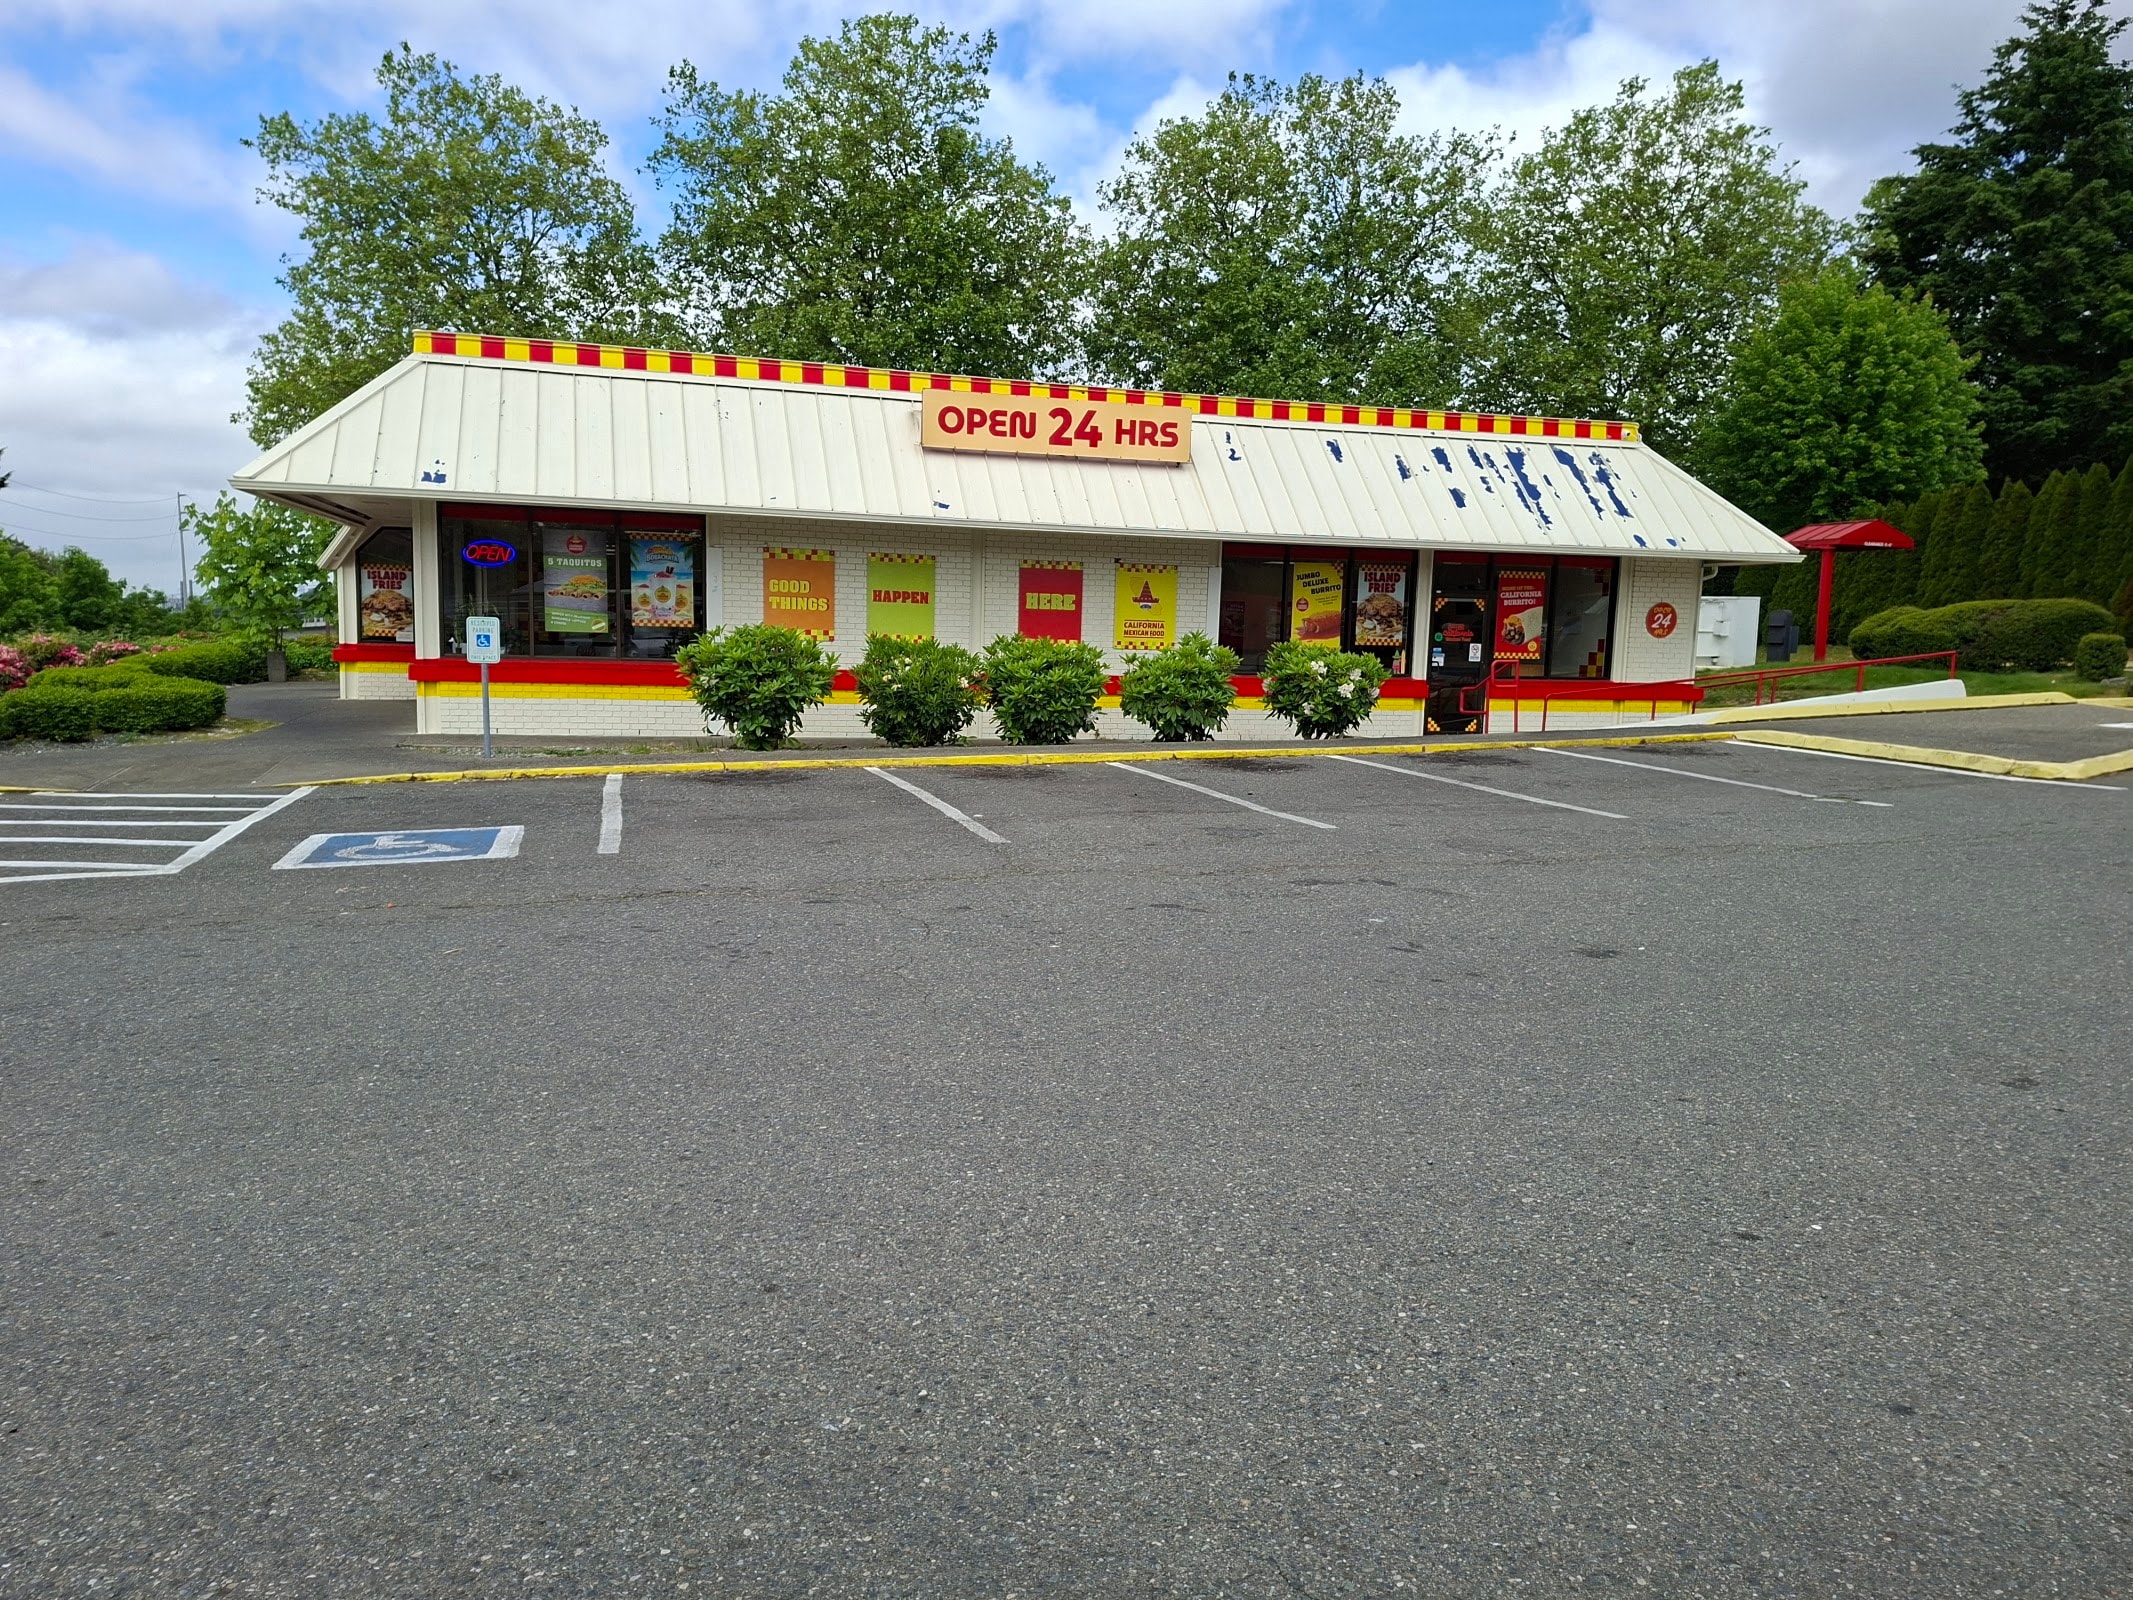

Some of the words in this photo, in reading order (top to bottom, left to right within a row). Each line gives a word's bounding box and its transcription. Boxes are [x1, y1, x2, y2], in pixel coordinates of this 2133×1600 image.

[937, 405, 1037, 439] OPEN
[1048, 407, 1103, 448] 24
[1115, 418, 1180, 448] HRS
[466, 544, 511, 562] OPEN
[547, 557, 554, 565] 5
[556, 558, 602, 567] TAQUITOS
[367, 570, 407, 581] ISLAND
[1296, 571, 1320, 580] JUMBO
[1363, 571, 1401, 583] ISLAND
[372, 580, 402, 590] FRIES
[768, 579, 811, 594] GOOD
[1302, 577, 1329, 588] DELUXE
[1368, 582, 1396, 593] FRIES
[1310, 584, 1341, 595] BURRITO
[1500, 590, 1542, 599] CALIFORNIA
[872, 589, 929, 604] HAPPEN
[1025, 592, 1076, 611] HERE
[1503, 598, 1536, 606] BURRITO!
[768, 596, 829, 611] THINGS
[1123, 621, 1165, 630] CALIFORNIA
[1651, 613, 1673, 628] 24
[1123, 629, 1149, 637] MEXICAN
